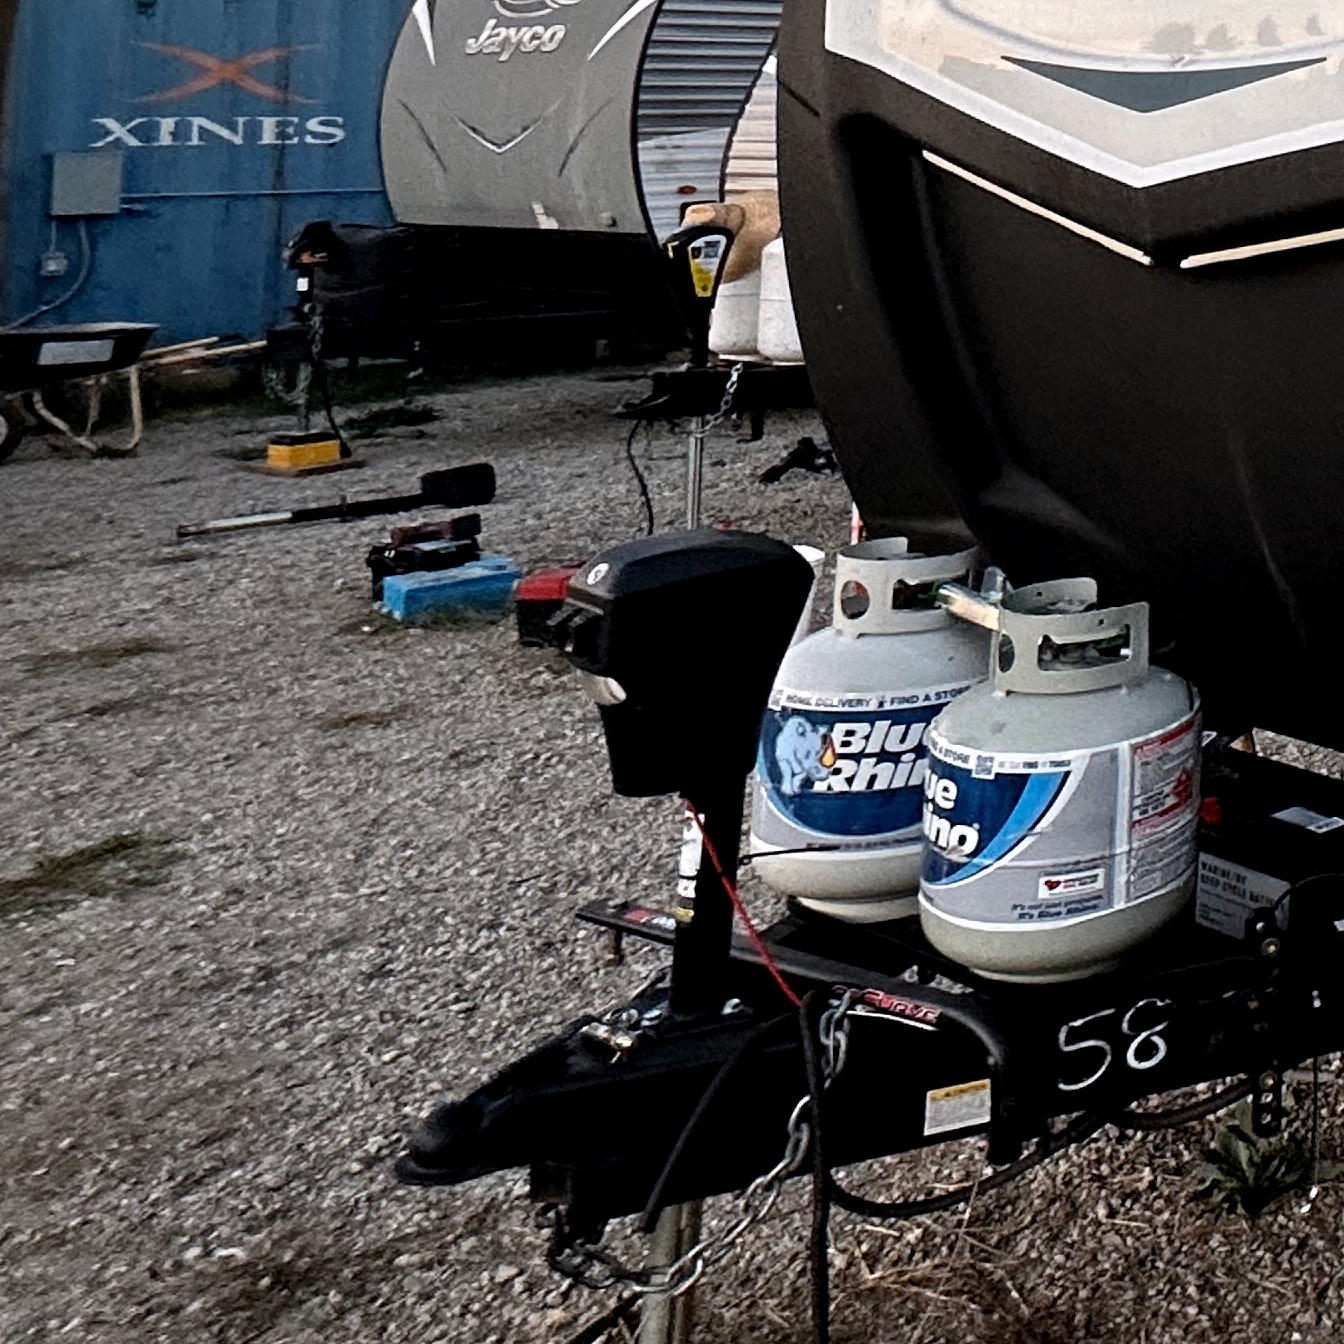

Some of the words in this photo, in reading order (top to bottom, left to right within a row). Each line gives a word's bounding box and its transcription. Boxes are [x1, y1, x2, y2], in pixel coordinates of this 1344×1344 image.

[464, 18, 568, 63] Jayco
[88, 115, 347, 149] XINES
[814, 697, 872, 708] DELIVERY
[890, 694, 920, 707] FIND
[923, 692, 933, 703] A
[830, 719, 928, 756] Blu
[812, 752, 930, 792] Rhin
[922, 767, 958, 810] ue
[922, 802, 980, 857] ino
[1057, 997, 1173, 1091] 58
